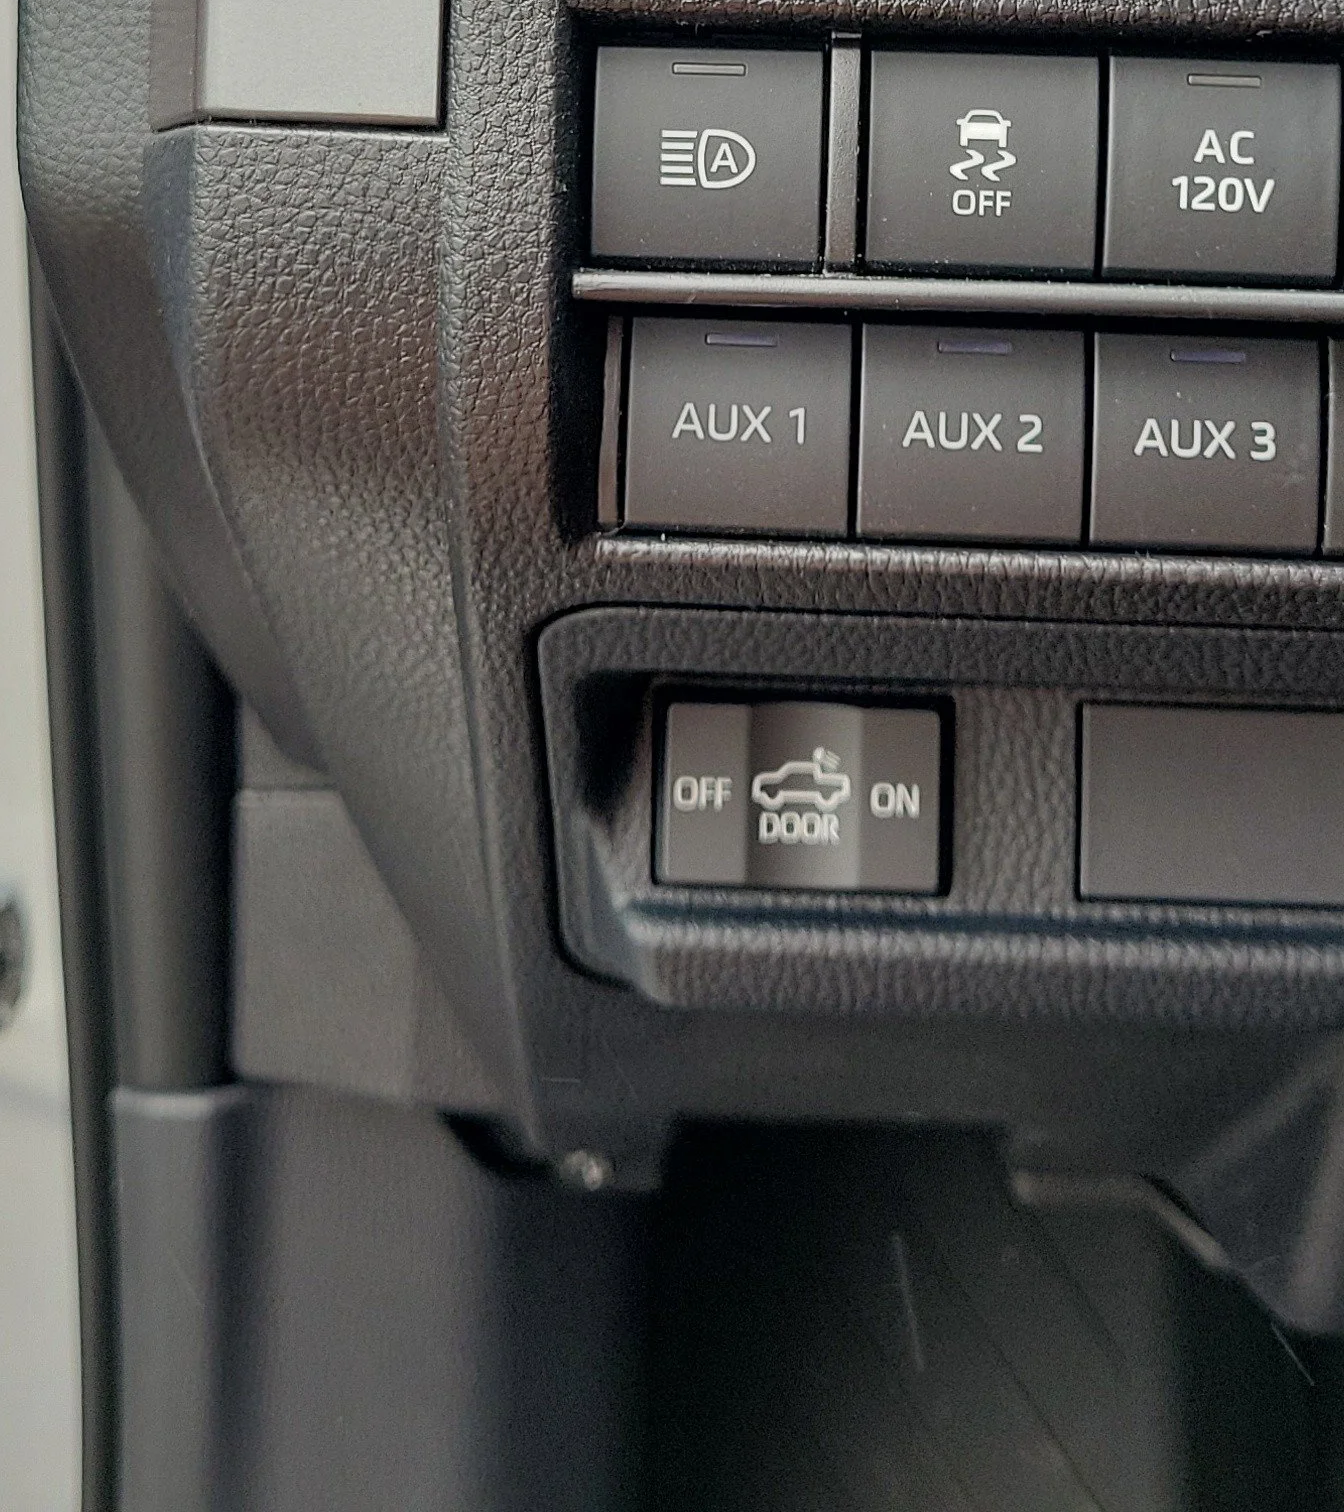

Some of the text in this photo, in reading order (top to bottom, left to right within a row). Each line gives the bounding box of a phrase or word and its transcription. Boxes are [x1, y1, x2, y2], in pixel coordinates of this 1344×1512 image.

[708, 142, 741, 175] A
[1193, 129, 1256, 166] AC
[952, 189, 1013, 218] OFF
[1172, 175, 1276, 214] 120V
[672, 402, 806, 446] AUX 1
[902, 410, 1044, 454] AUX 2
[1134, 418, 1277, 462] AUX 3
[673, 776, 733, 812] OFF
[870, 782, 921, 819] ON
[759, 811, 841, 846] DOOR
